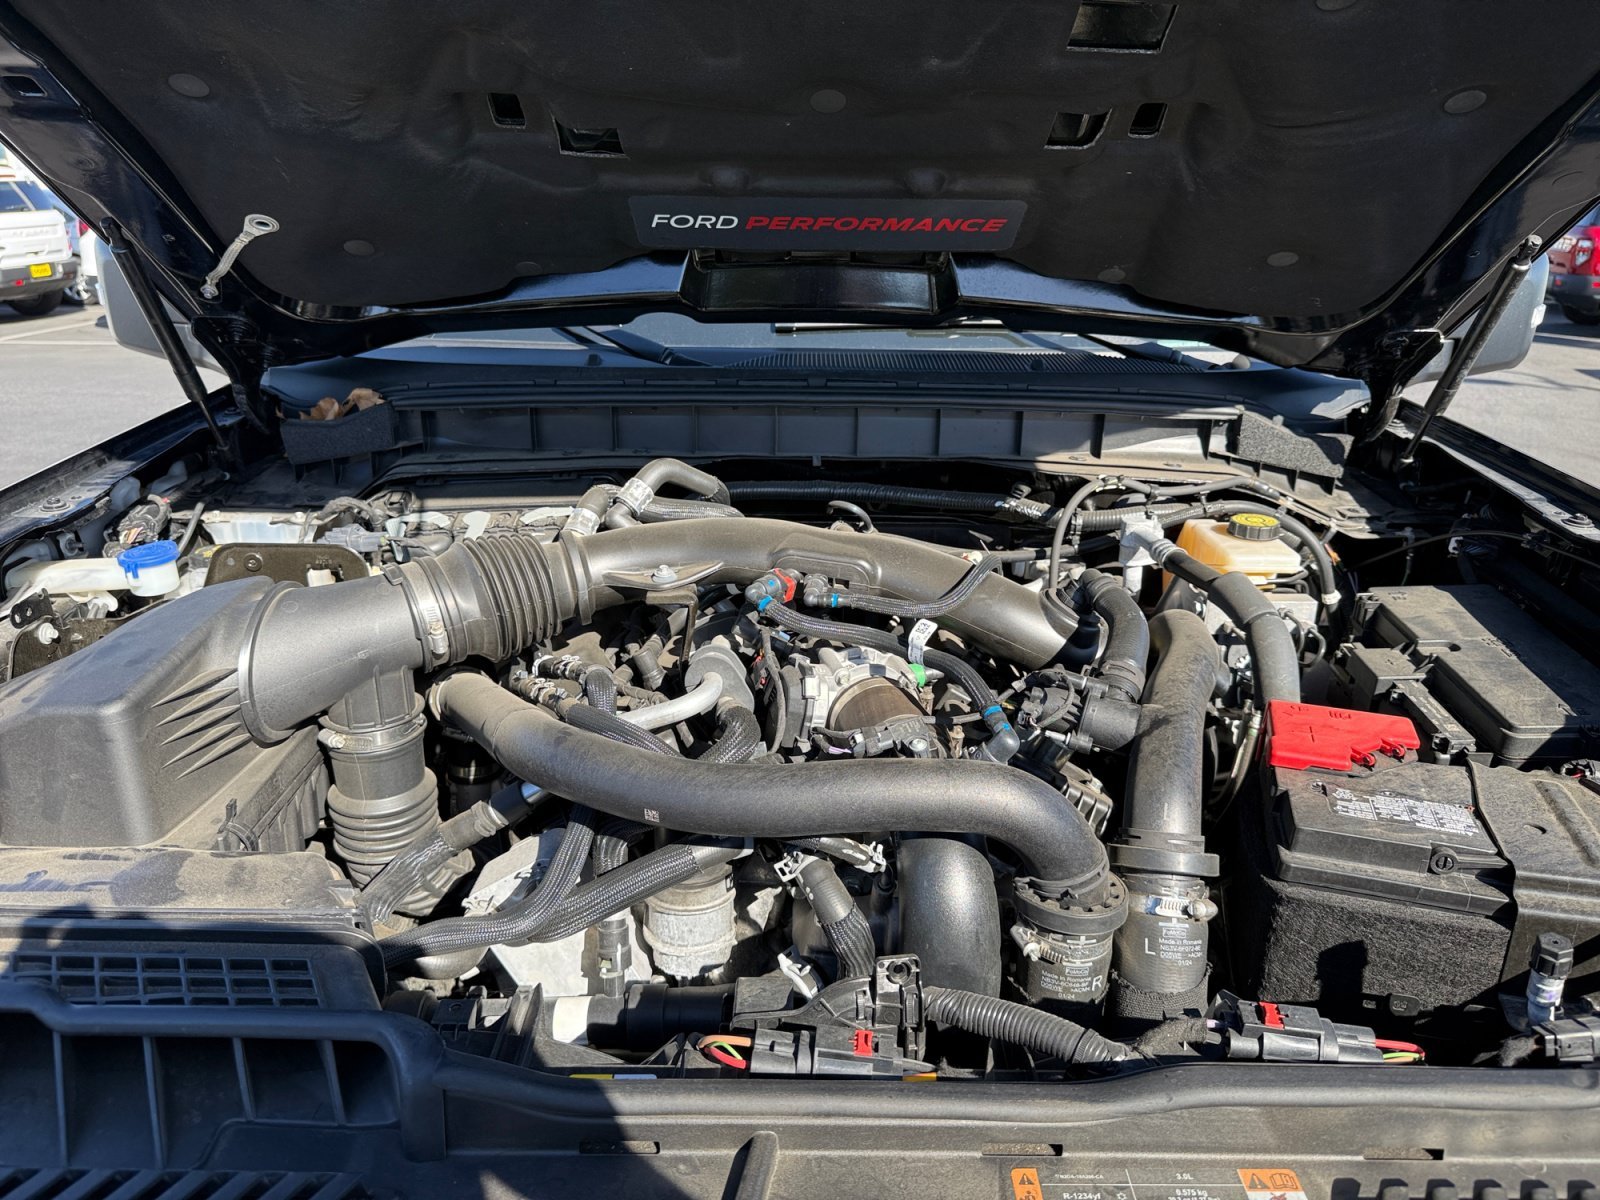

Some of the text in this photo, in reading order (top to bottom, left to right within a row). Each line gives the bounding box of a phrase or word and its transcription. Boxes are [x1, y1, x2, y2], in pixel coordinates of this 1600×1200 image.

[651, 214, 1009, 233] FORD PERFORMANCE
[1144, 937, 1156, 955] L
[1042, 970, 1059, 979] Made
[1091, 975, 1103, 992] R
[1063, 1192, 1101, 1200] R-1234yf
